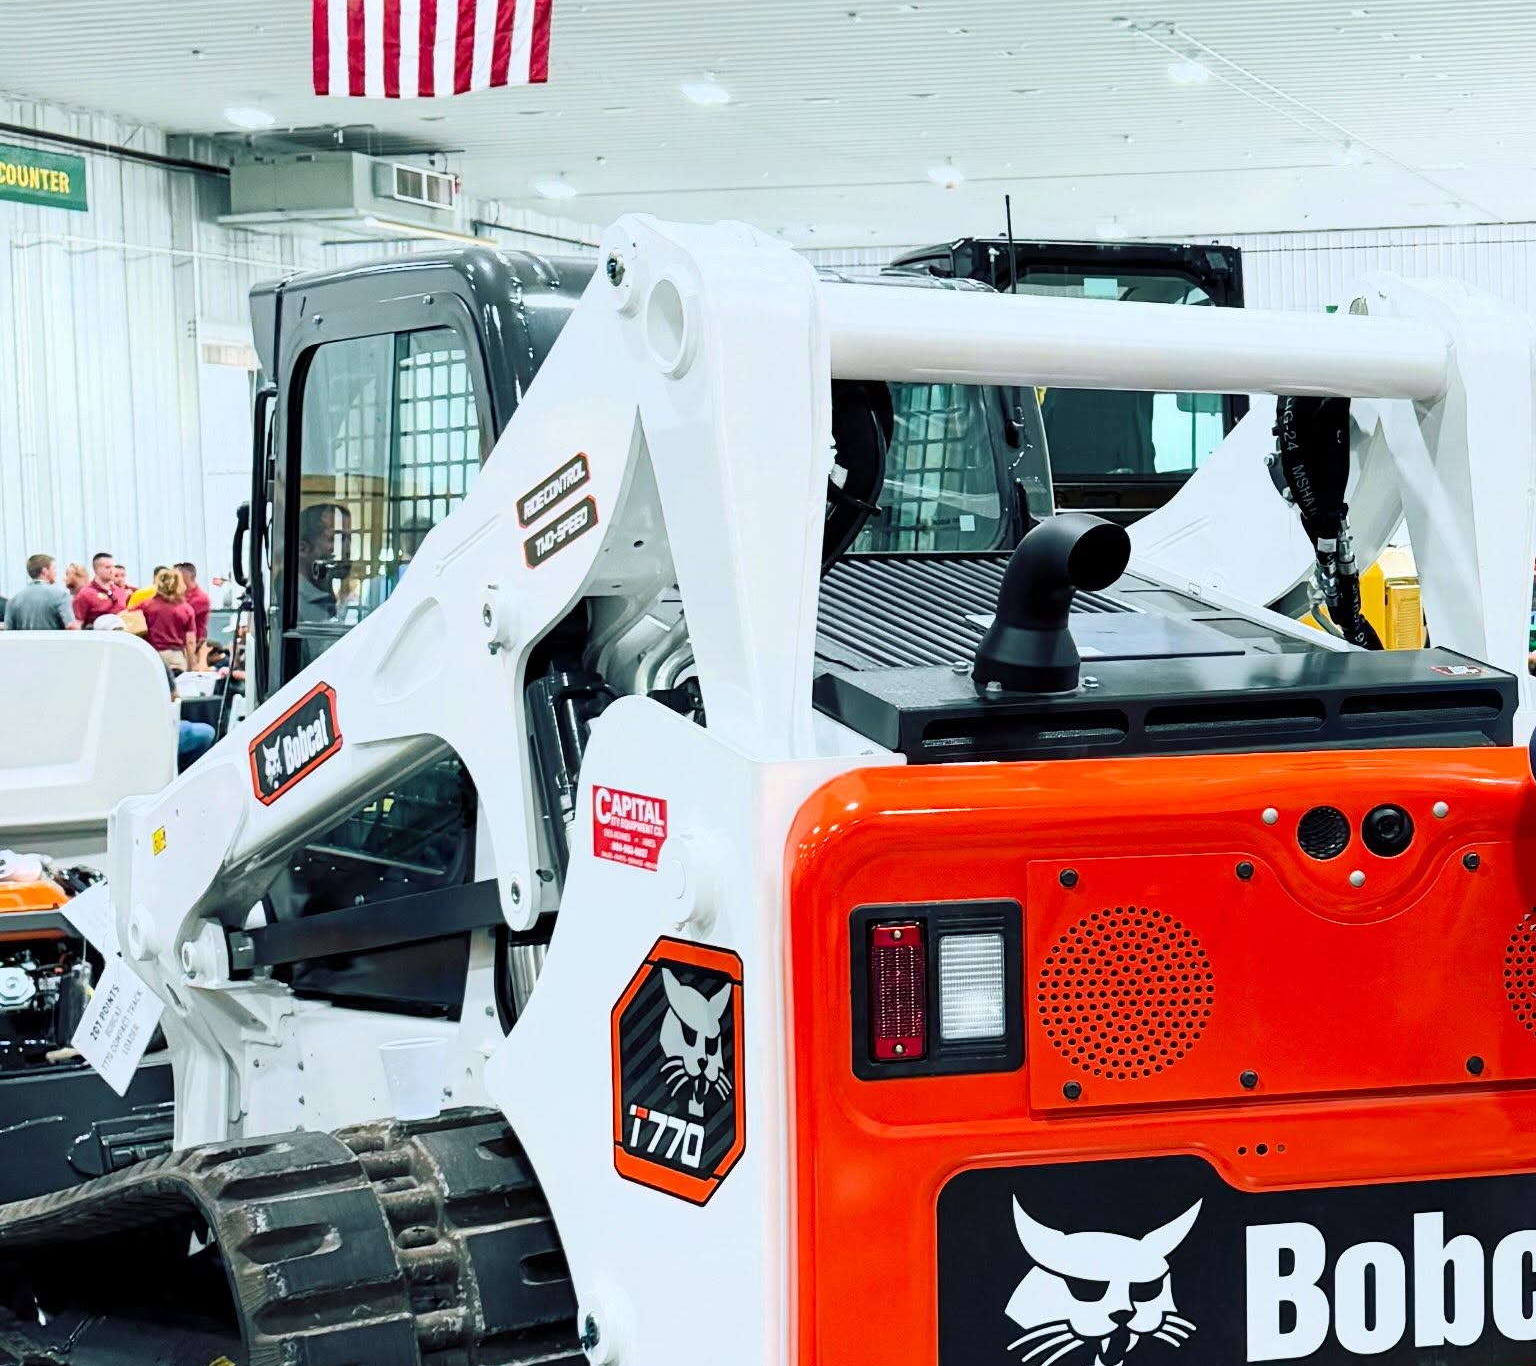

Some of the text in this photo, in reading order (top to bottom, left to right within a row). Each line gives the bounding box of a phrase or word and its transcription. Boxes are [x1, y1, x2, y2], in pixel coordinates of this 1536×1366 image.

[535, 506, 588, 557] TWO-SPEED
[282, 708, 329, 776] Bobcat
[595, 787, 665, 826] CAPITAL
[90, 984, 120, 1041] 207 POINTS
